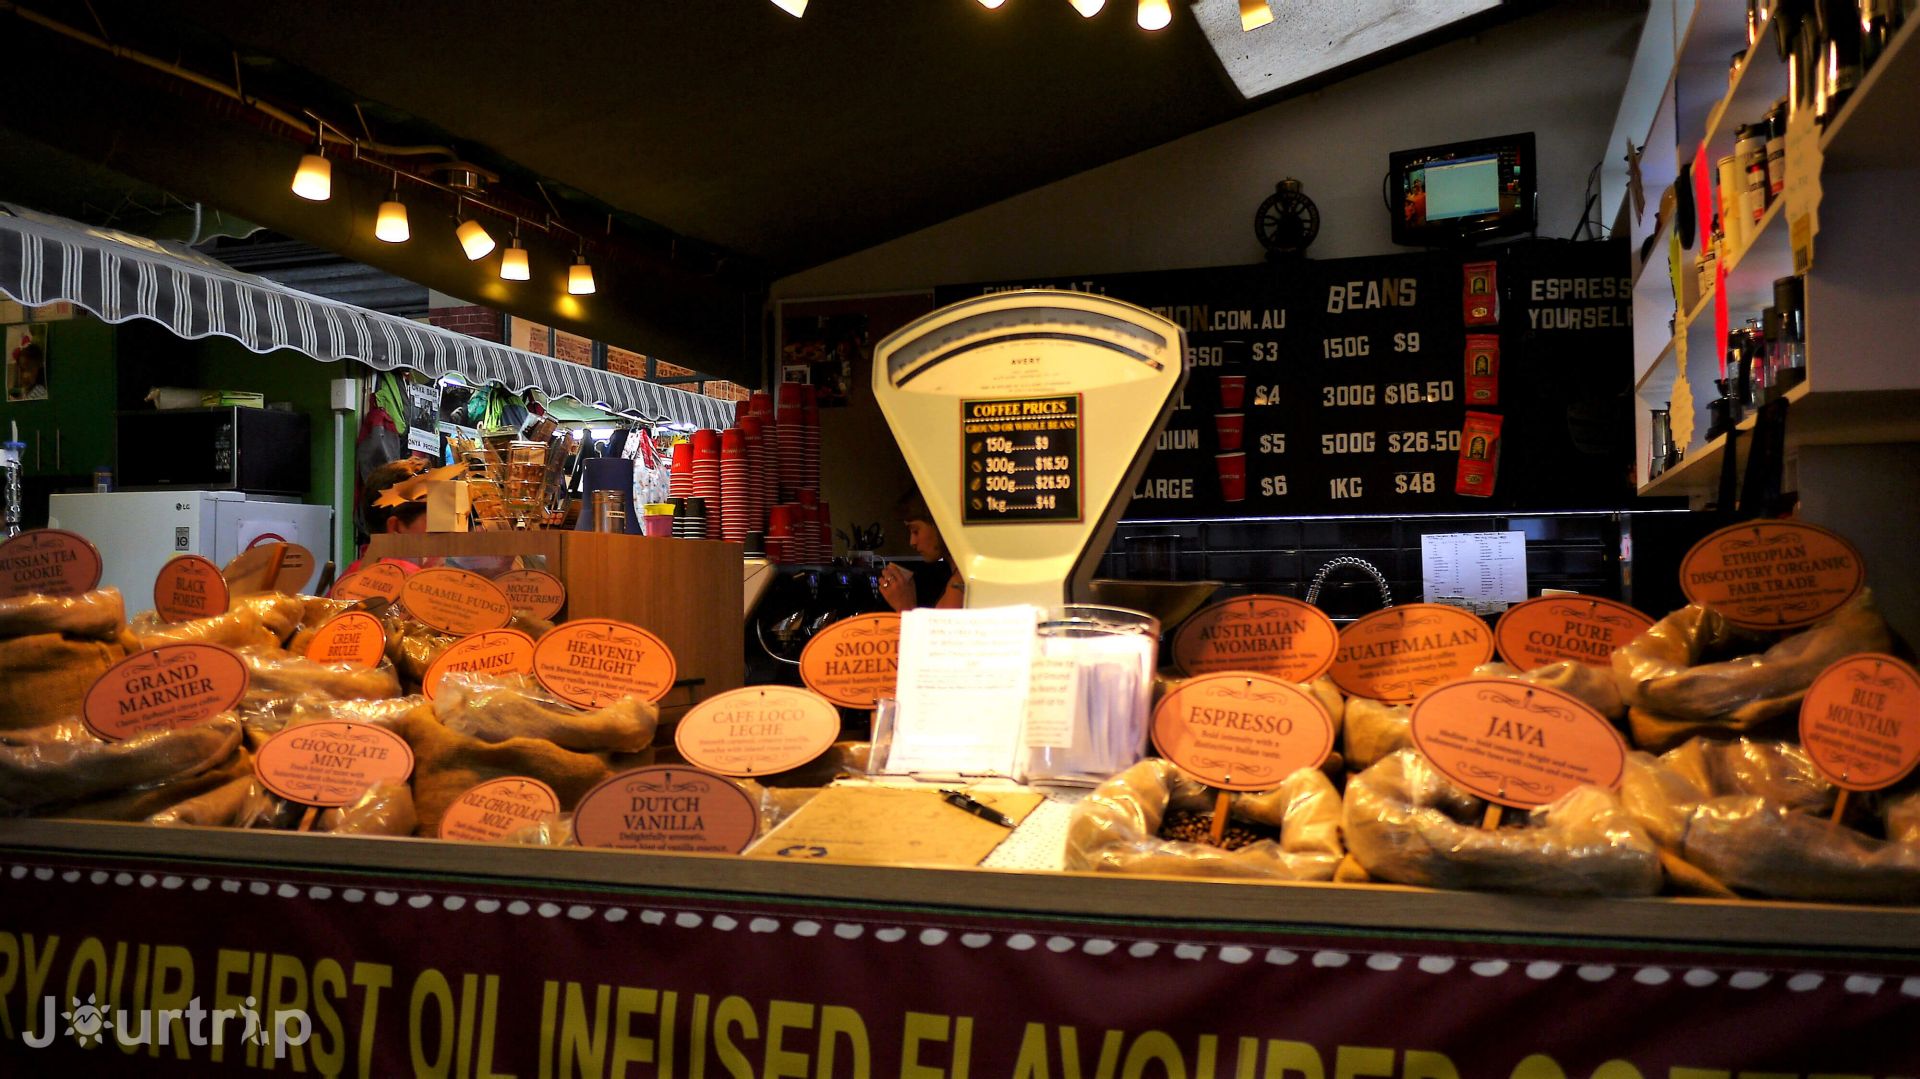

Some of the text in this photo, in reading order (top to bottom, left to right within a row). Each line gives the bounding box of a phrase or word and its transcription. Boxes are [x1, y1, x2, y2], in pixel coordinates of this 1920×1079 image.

[1327, 278, 1417, 314] BEANS
[1251, 341, 1279, 362] $3
[1323, 332, 1420, 359] 150G $9
[1011, 357, 1041, 366] AVERY
[1254, 384, 1281, 406] $4
[1323, 384, 1376, 407] 300G
[1385, 380, 1454, 405] $16.50
[973, 400, 1067, 417] COFFEE PRICES
[1001, 422, 1014, 432] OR
[1015, 421, 1046, 431] WHOLE
[1047, 419, 1076, 430] BEANS
[1156, 429, 1286, 454] DIUM $5
[1321, 430, 1462, 455] 500G $26.50
[1132, 475, 1288, 500] LARGE $6
[1330, 472, 1436, 499] 1KG $48
[54, 550, 77, 562] TEA
[1722, 545, 1807, 566] ETHIOPIAN
[13, 565, 64, 581] COOKIE
[1691, 556, 1850, 585] DISCOVERY ORGANIC
[175, 577, 205, 593] BLACK
[505, 583, 539, 594] MOCHA
[1728, 581, 1763, 597] FAIR
[1766, 576, 1818, 592] TRADE
[172, 592, 206, 609] FOREST
[408, 580, 463, 604] CARAMEL
[467, 595, 506, 615] FUDGE
[1199, 619, 1306, 641] AUSTRALIAN
[1564, 620, 1614, 642] PURE
[567, 639, 645, 663] HEAVENLY
[834, 639, 900, 658] SMOOT
[1213, 636, 1293, 654] WOMBAH
[1335, 627, 1479, 663] GUATEMALAN
[447, 652, 515, 673] TIRAMISU
[569, 654, 637, 676] DELIGHT
[825, 657, 899, 676] HAZELN
[125, 664, 199, 694] GRAND
[118, 677, 214, 715] MARNIER
[1851, 687, 1887, 712] BLUE
[712, 708, 806, 724] CAFE LOCO
[1189, 706, 1293, 736] ESPRESSO
[1826, 703, 1900, 738] MOUNTAIN
[728, 723, 784, 737] LECHE
[1485, 716, 1546, 748] JAVA
[290, 737, 389, 760] CHOCOLATE
[310, 753, 356, 769] MINT
[463, 792, 548, 822] OLE CHOCOLAT
[631, 796, 699, 813] DUTCH
[480, 812, 514, 830] MOLE
[624, 814, 705, 831] VANILLA
[64, 936, 196, 1060] OUR
[211, 947, 394, 1079] FIRST
[408, 967, 519, 1079] OIL
